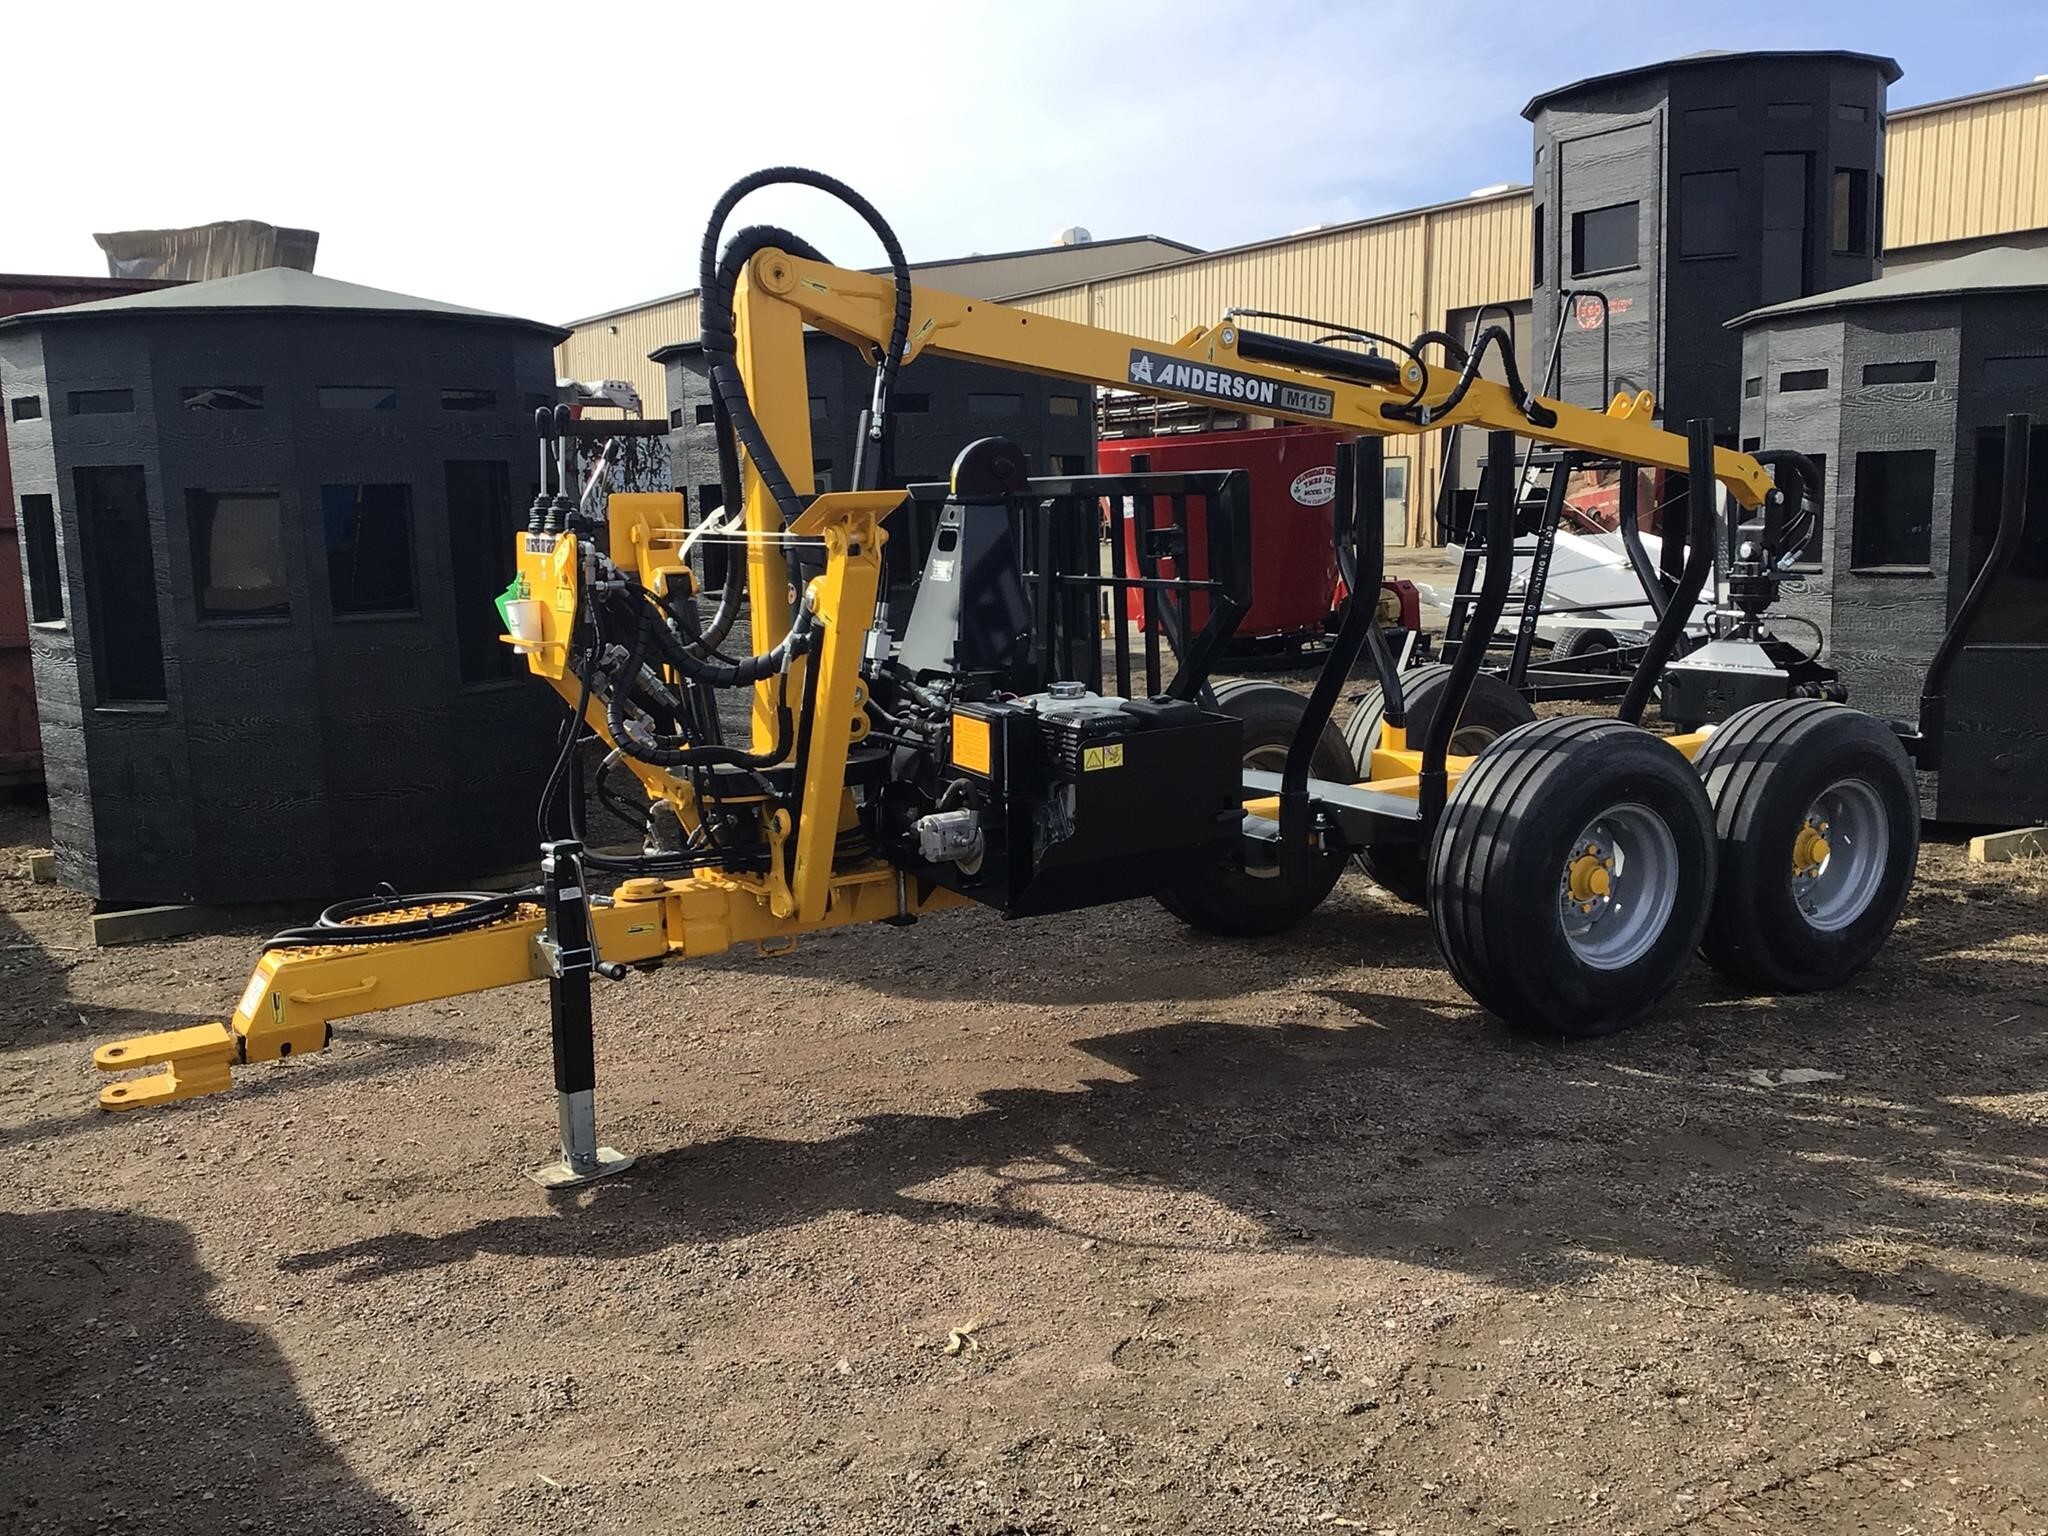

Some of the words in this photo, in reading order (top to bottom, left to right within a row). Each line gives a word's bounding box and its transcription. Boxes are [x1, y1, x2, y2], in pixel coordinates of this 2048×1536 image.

[1156, 363, 1275, 404] ANDERSON
[1286, 390, 1328, 412] M115
[1304, 488, 1322, 496] MODEL
